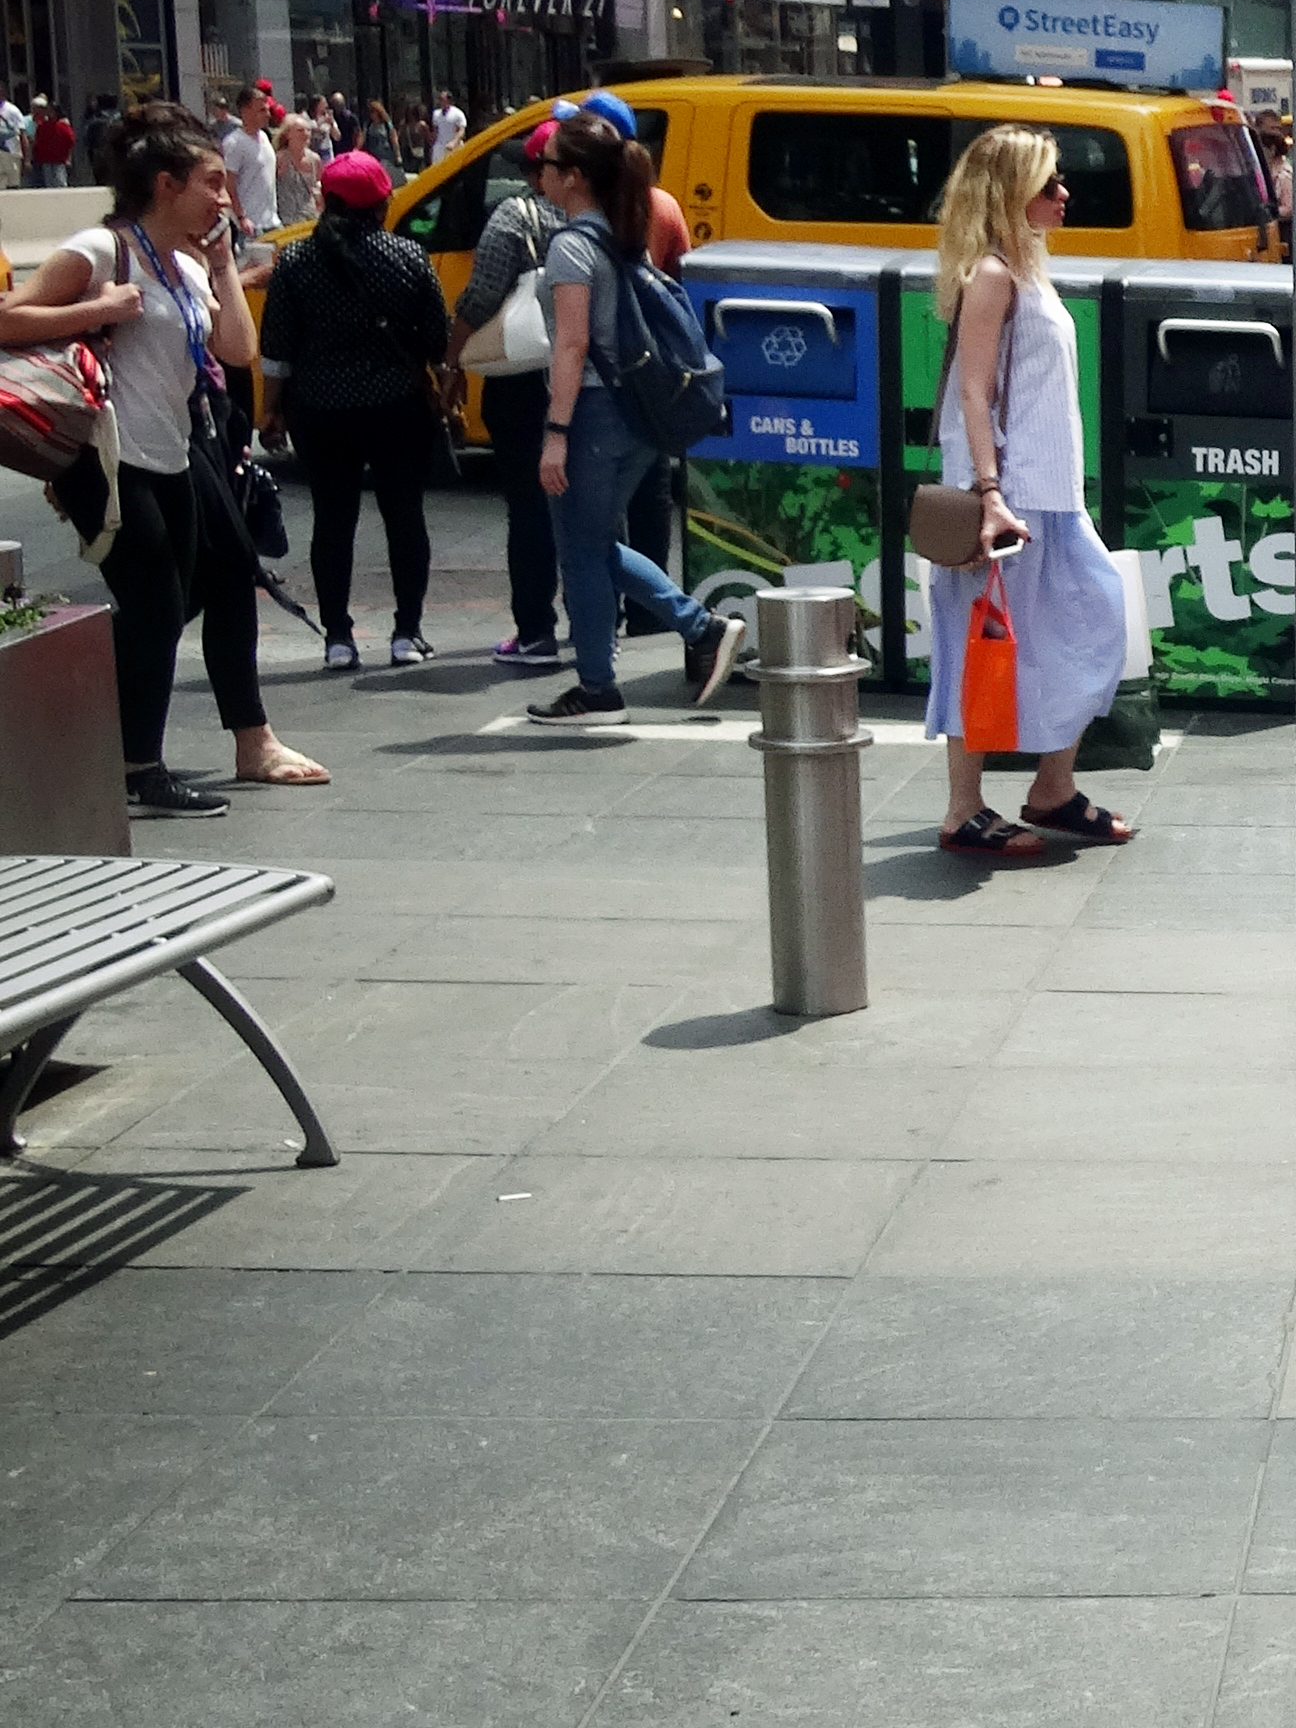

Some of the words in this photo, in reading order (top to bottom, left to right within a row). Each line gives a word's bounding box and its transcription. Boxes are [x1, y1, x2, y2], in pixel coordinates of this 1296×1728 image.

[1025, 8, 1160, 44] StreetEasy
[750, 415, 797, 435] CANS
[800, 418, 815, 437] &
[784, 436, 860, 458] BOTTLES
[1191, 446, 1280, 476] TRASH
